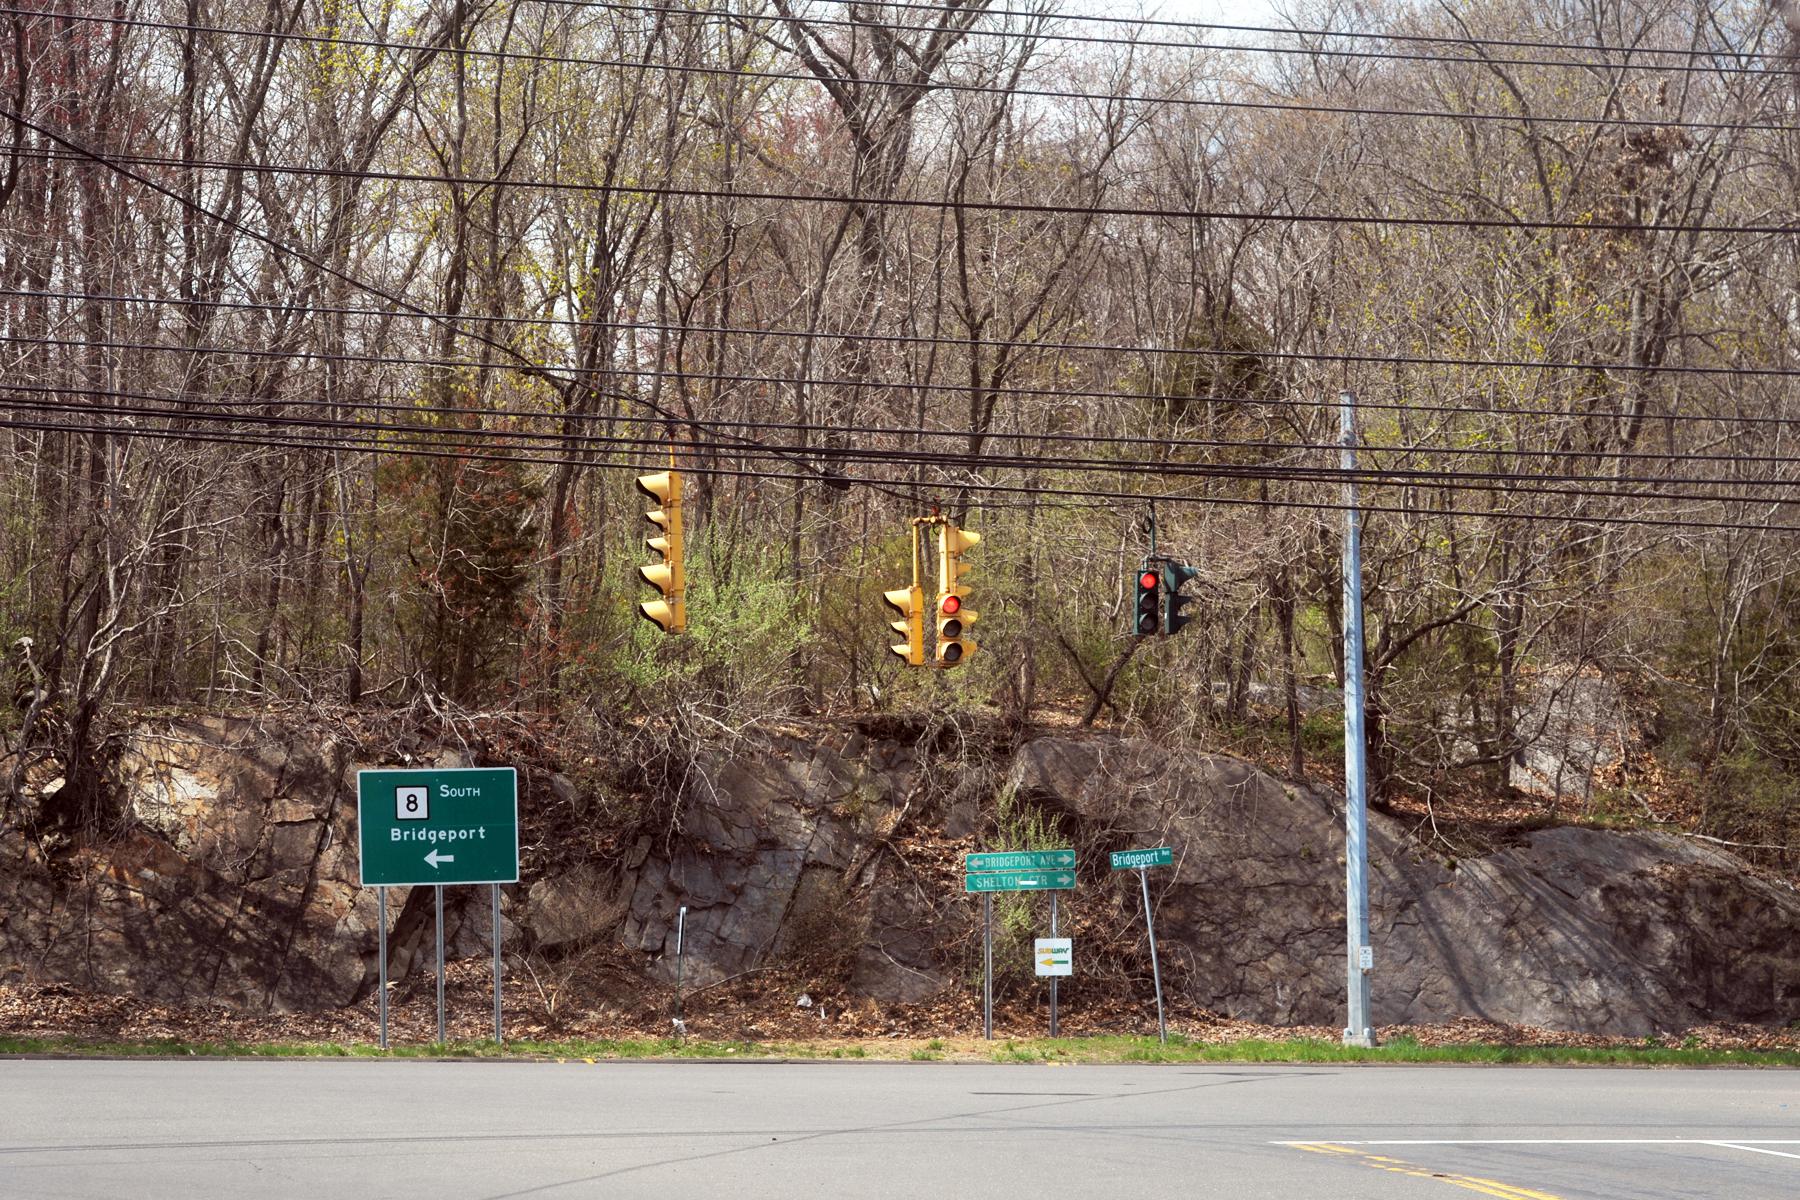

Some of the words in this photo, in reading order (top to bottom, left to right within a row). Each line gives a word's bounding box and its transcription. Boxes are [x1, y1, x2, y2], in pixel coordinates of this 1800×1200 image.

[439, 784, 480, 797] SOUTH
[406, 794, 418, 812] 8
[390, 826, 485, 844] Bridgeport
[985, 856, 1035, 868] BRIDGEPORT
[1040, 854, 1055, 865] AVE
[1112, 851, 1159, 867] Bridgeport
[976, 876, 1021, 888] SHELTON
